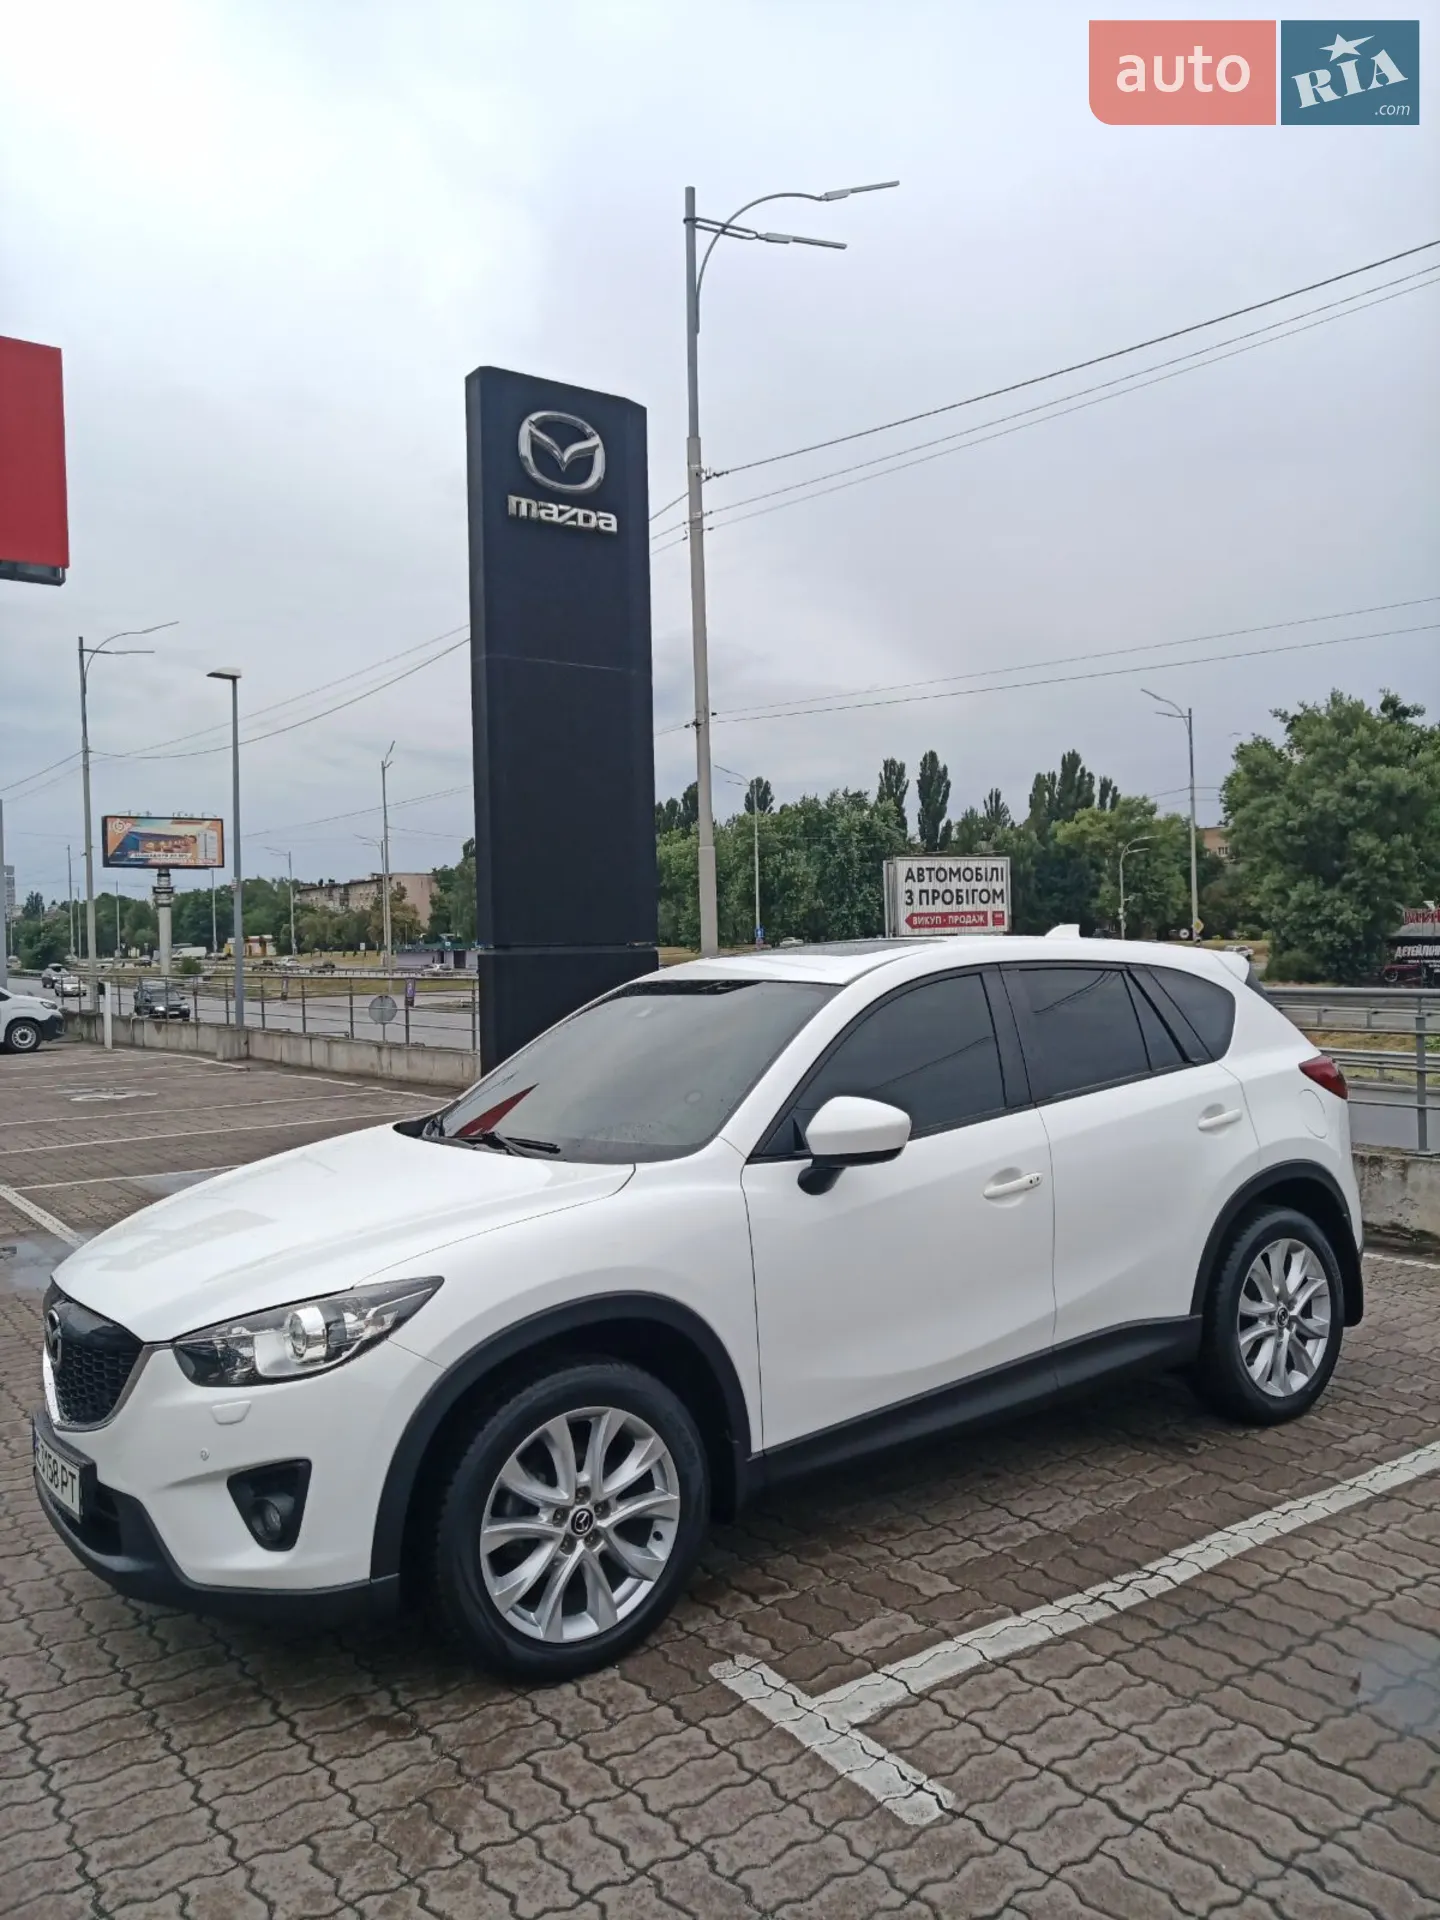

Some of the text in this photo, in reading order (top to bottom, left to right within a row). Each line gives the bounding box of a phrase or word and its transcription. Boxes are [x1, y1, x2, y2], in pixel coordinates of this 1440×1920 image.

[507, 495, 618, 535] mazda
[904, 866, 1004, 883] АВТОМОБІЛІ
[918, 888, 1005, 906] ПРОБІГОМ
[912, 916, 942, 926] ВИКУП
[948, 914, 985, 925] ПРОДАЖ
